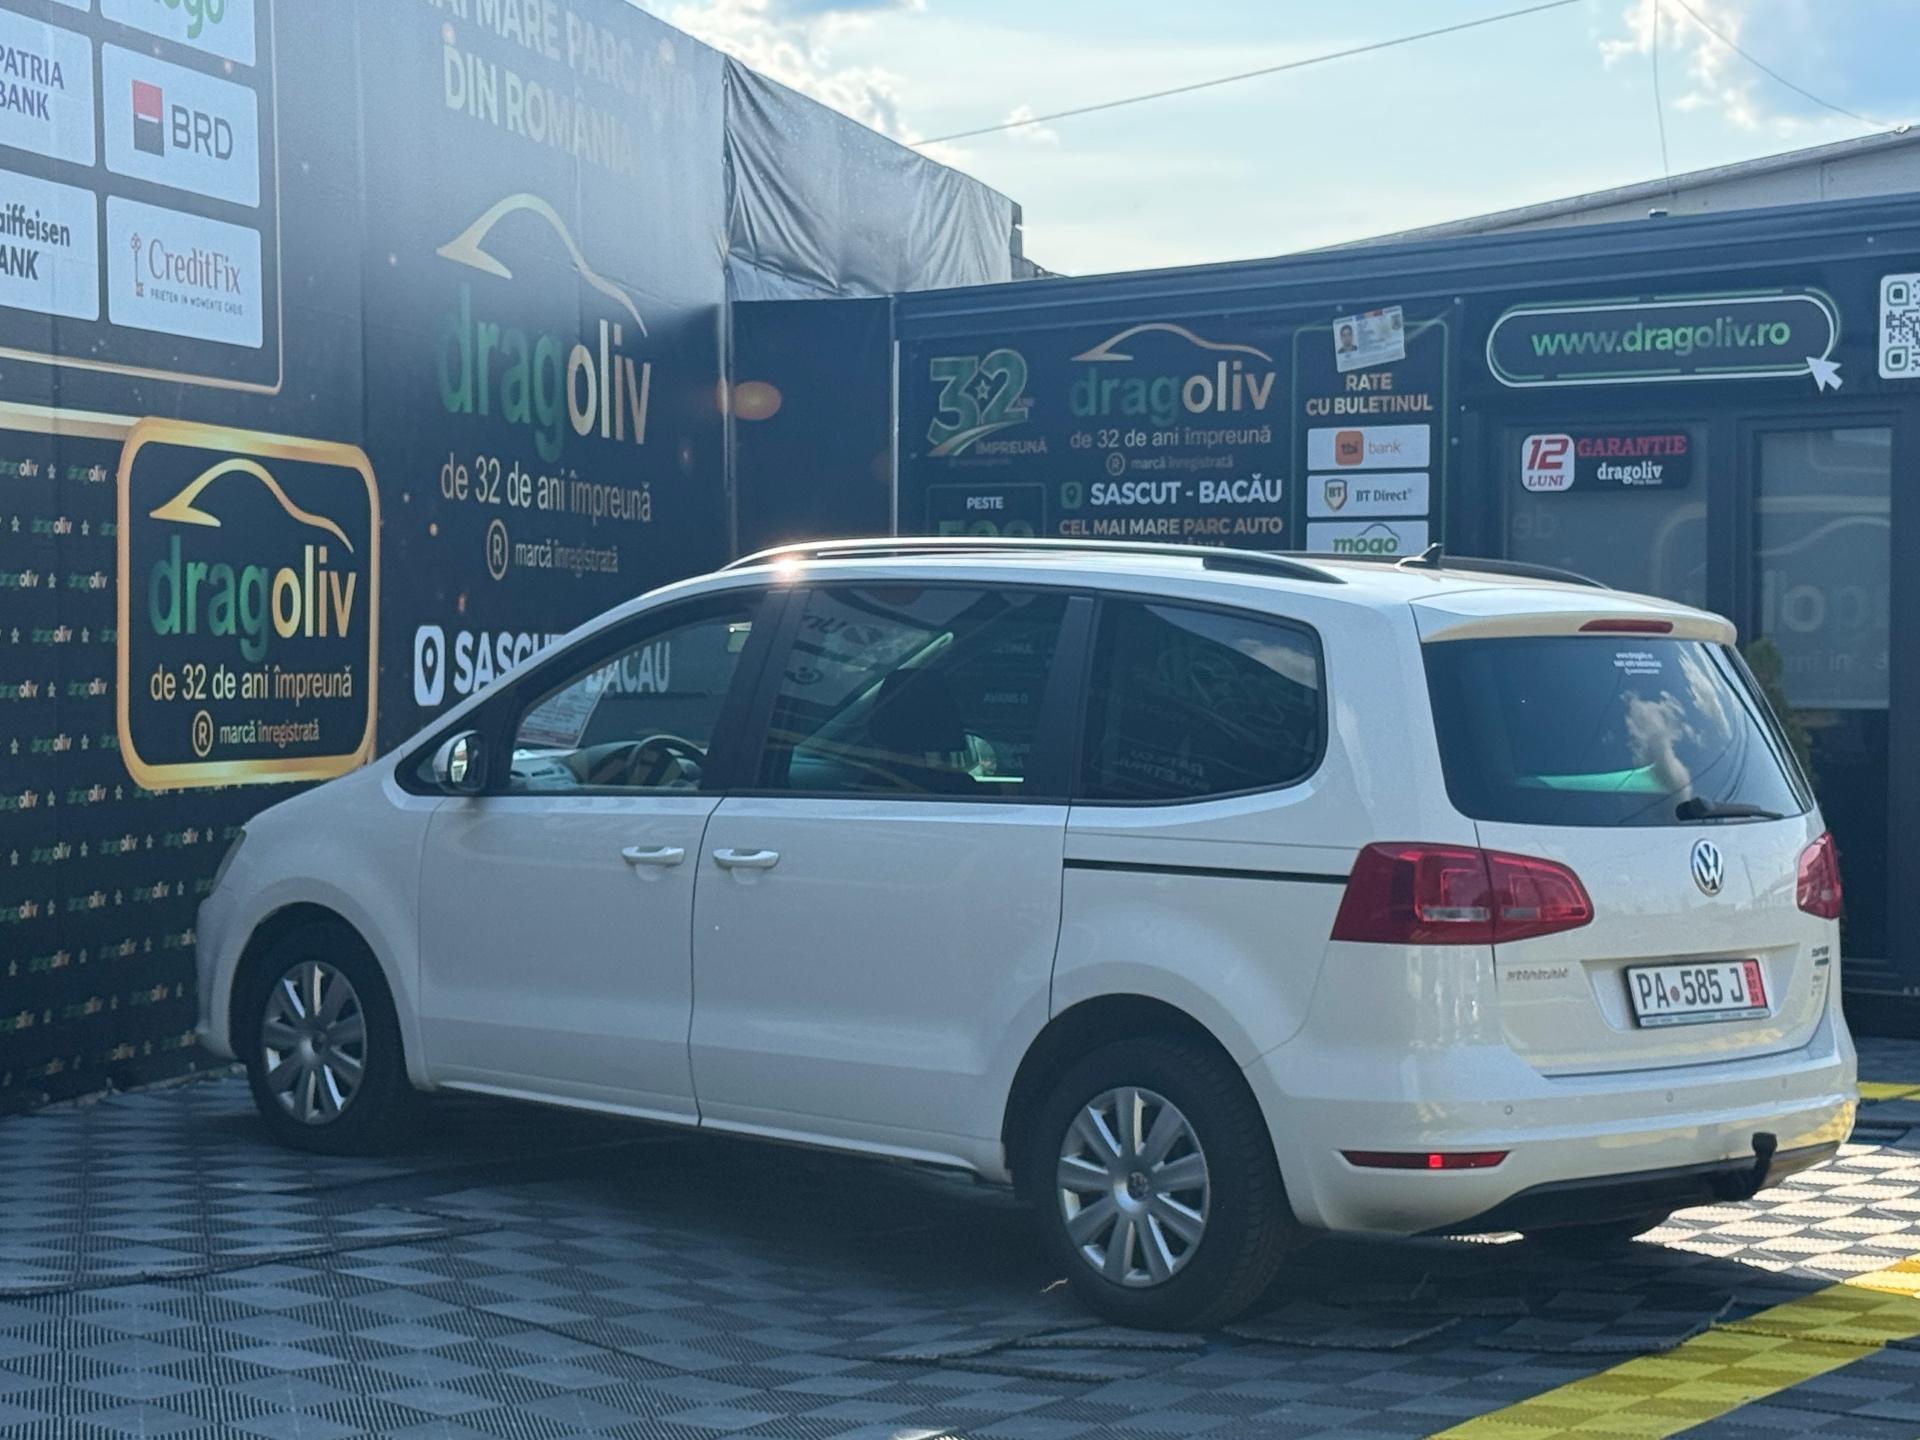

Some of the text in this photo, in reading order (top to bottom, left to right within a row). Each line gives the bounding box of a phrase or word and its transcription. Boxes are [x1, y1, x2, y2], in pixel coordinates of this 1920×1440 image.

[153, 0, 225, 39] go
[443, 42, 498, 126] DIN
[171, 103, 234, 161] BRD
[148, 238, 242, 295] CreditFix
[1531, 316, 1791, 358] www.dragoliv.ro
[438, 283, 651, 463] dragoliv
[1345, 373, 1393, 391] RATE
[1069, 360, 1276, 427] dragoliv
[1306, 394, 1434, 416] CU BULETINUL
[1070, 431, 1092, 449] de
[1097, 429, 1119, 448] 32
[1125, 428, 1147, 447] de
[1152, 427, 1179, 447] ani
[1368, 441, 1401, 455] bank
[1527, 438, 1569, 471] 12
[1577, 434, 1687, 458] GARANTIE
[1527, 474, 1565, 487] LUNI
[1596, 460, 1664, 485] dragoliv
[441, 453, 651, 526] de 32 de ani împreună
[966, 496, 1004, 510] PESTE
[1090, 481, 1181, 506] SASCUT
[1199, 473, 1283, 504] BACĂU
[1356, 489, 1371, 502] BT
[1059, 516, 1283, 536] CEL MAI MARE PARC AUTO
[515, 539, 552, 569] marcă
[149, 534, 356, 662] dragoliv
[150, 664, 352, 706] de 32 de ani împreună
[219, 721, 256, 745] marcă
[1635, 970, 1671, 1011] PA
[1679, 967, 1724, 1007] 585
[1729, 966, 1745, 1004] J
